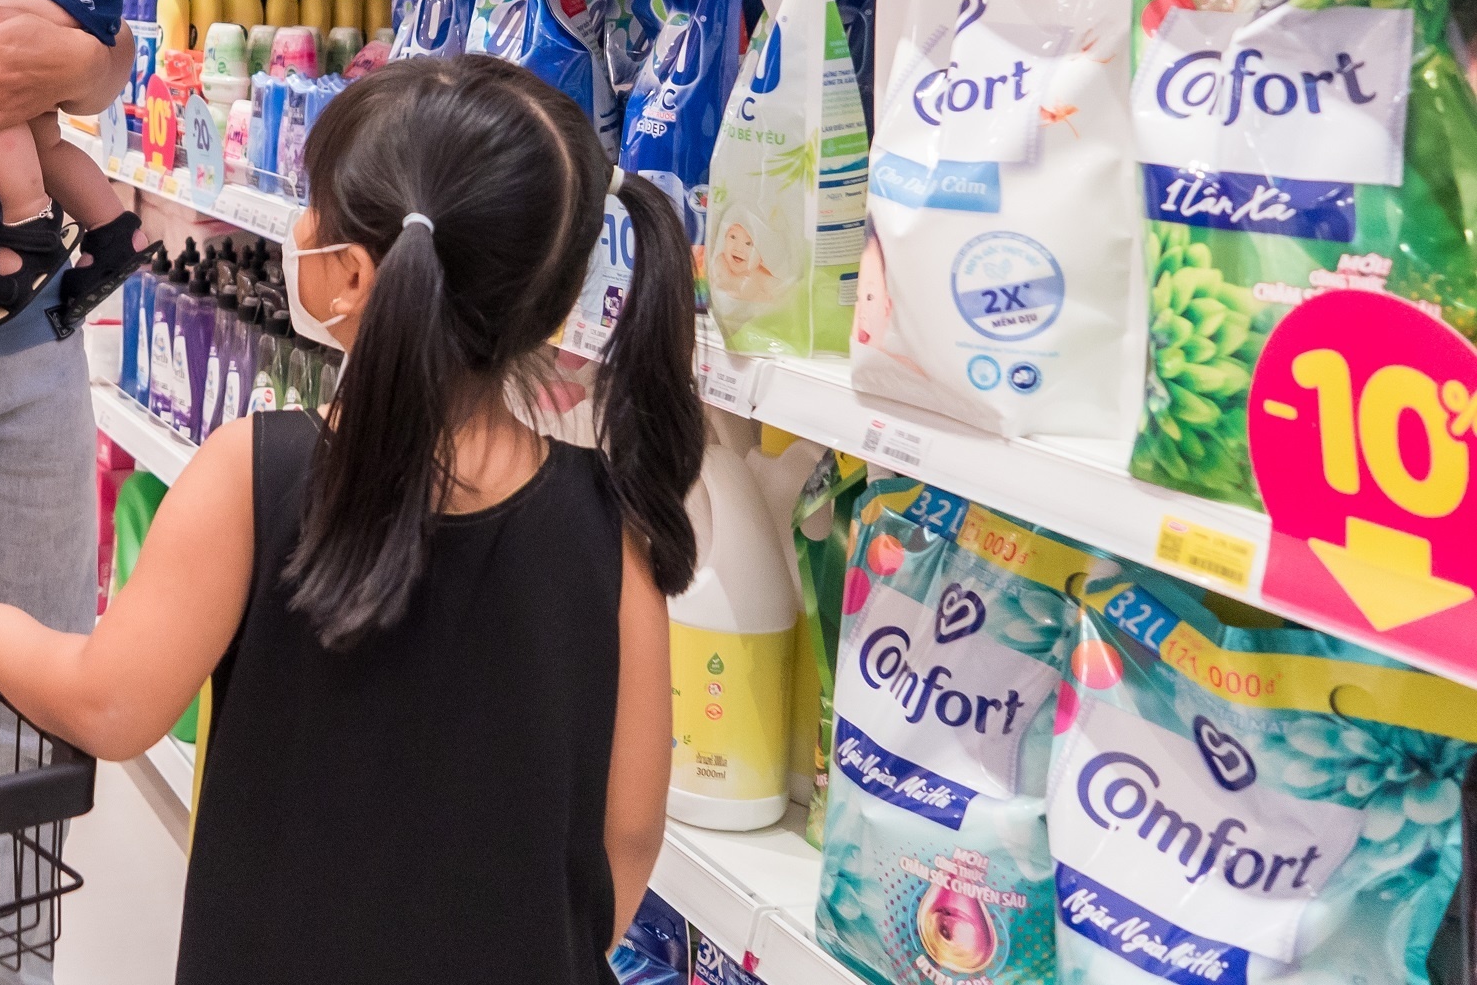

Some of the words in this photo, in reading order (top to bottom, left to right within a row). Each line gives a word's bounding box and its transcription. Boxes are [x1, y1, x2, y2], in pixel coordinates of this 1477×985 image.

[859, 624, 1025, 735] Comfort
[695, 767, 727, 780] 3000ml
[1077, 750, 1322, 892] Comfort
